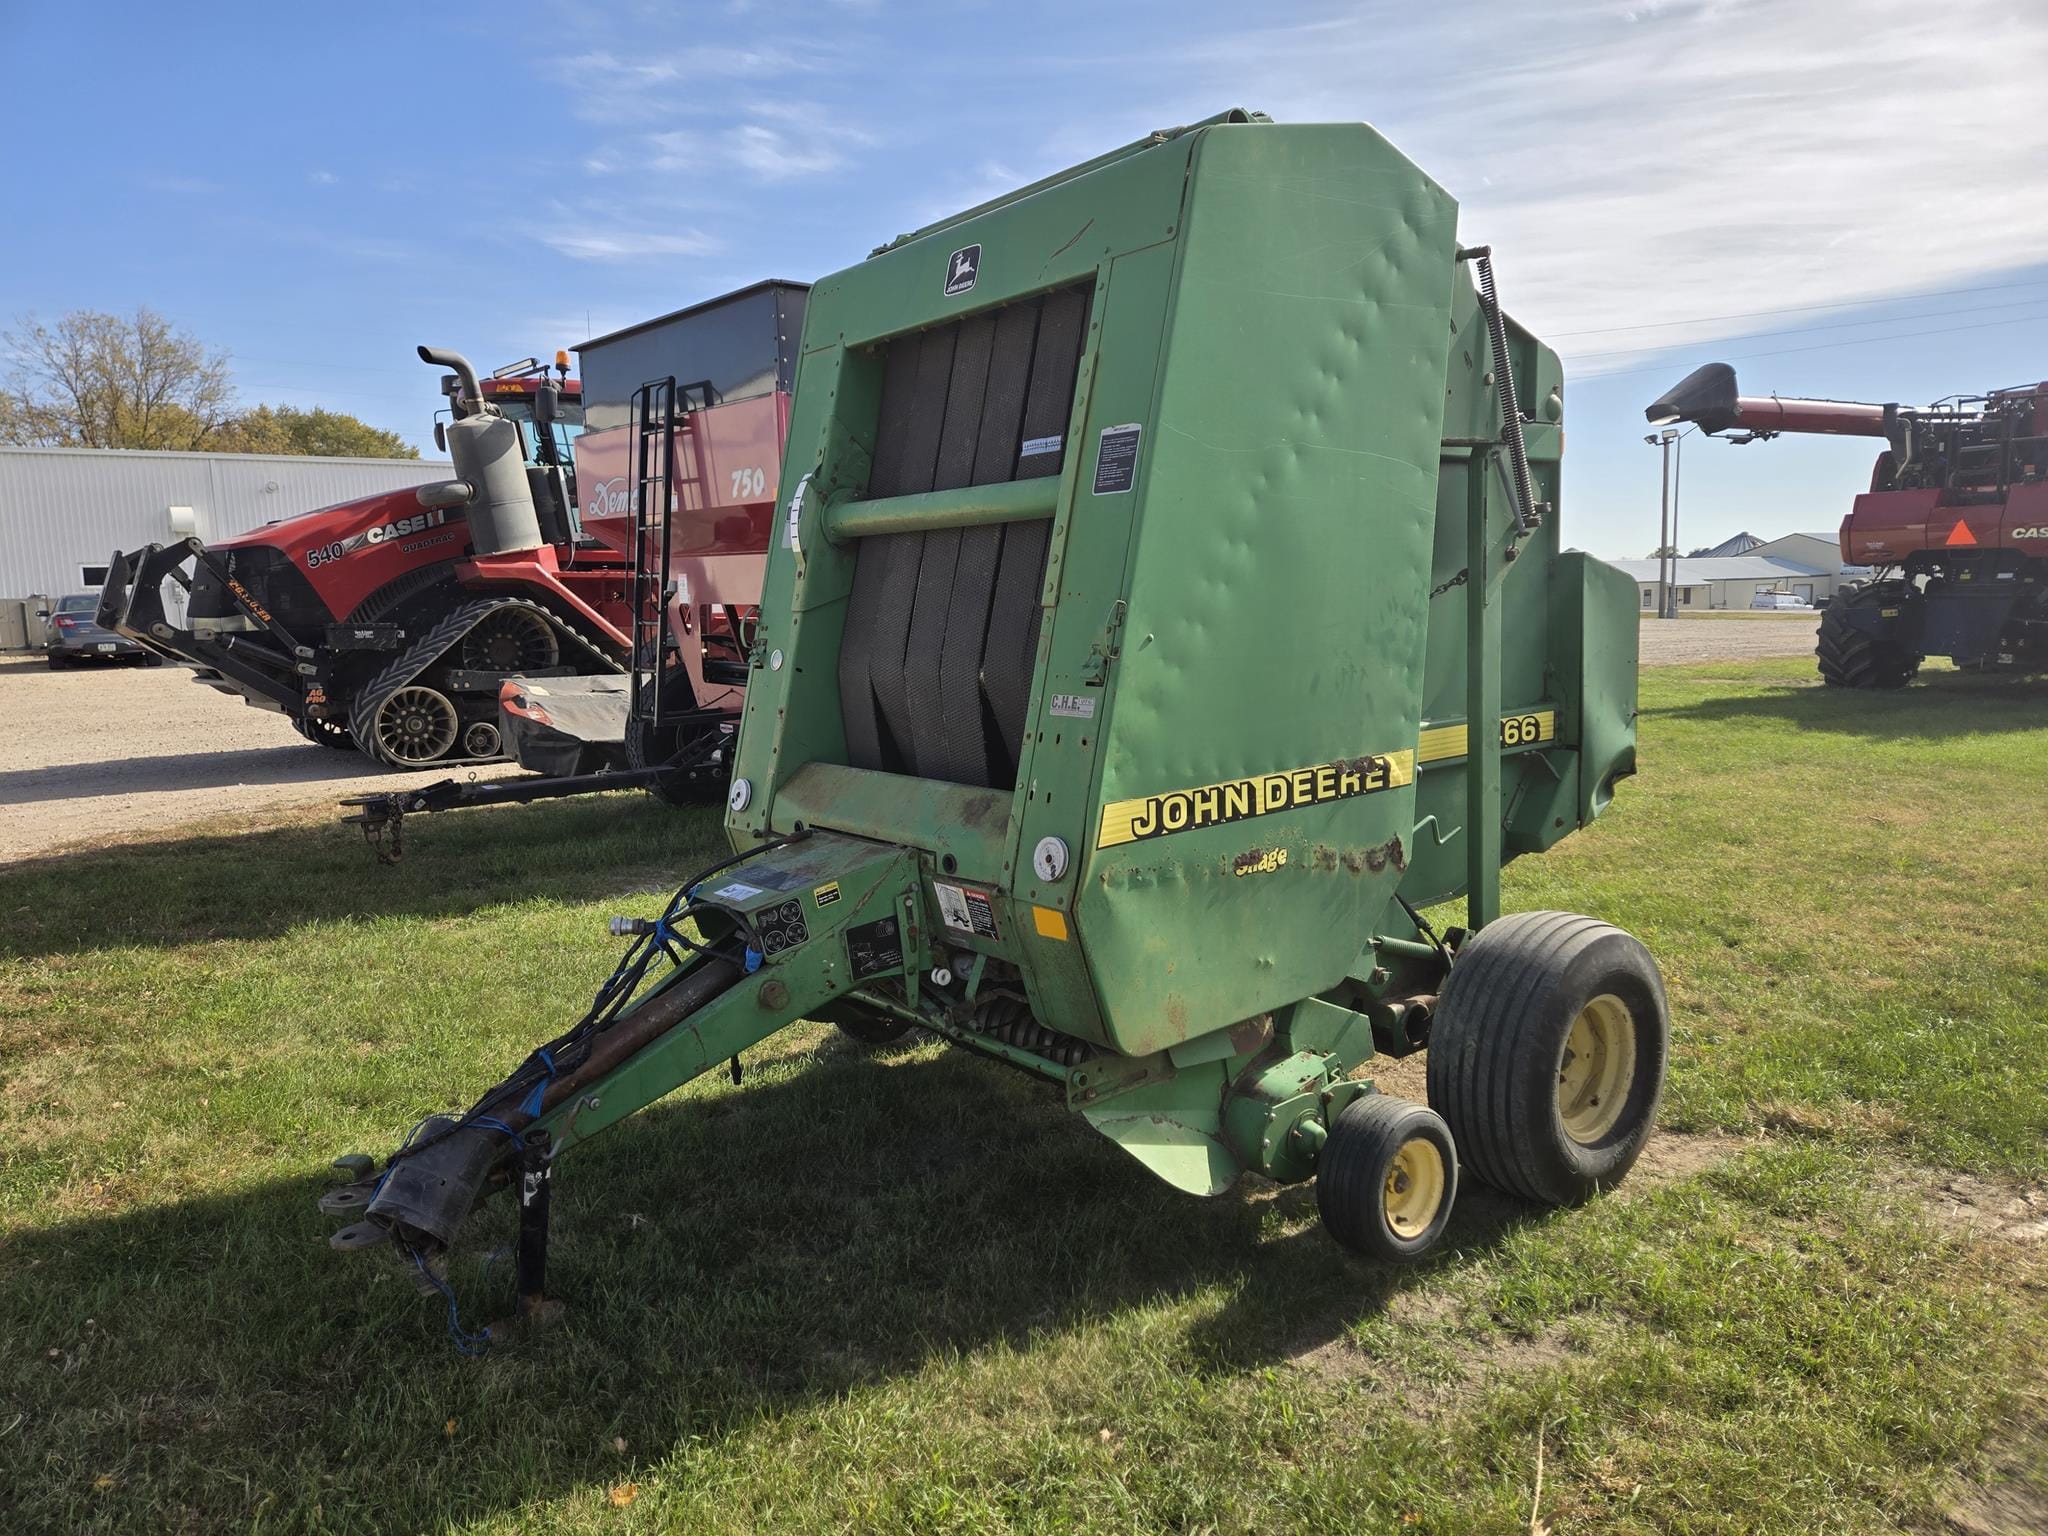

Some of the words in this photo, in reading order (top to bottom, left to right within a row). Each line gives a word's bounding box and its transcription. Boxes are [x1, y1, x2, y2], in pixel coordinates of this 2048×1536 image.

[589, 477, 638, 515] Demc
[732, 468, 765, 498] 750
[367, 514, 426, 544] CASE
[402, 532, 456, 553] QUADTRAC
[307, 541, 344, 568] 540
[305, 696, 326, 704] PRO
[1500, 716, 1538, 745] 66
[1132, 782, 1257, 837] JOHN
[1264, 757, 1385, 811] DEERE
